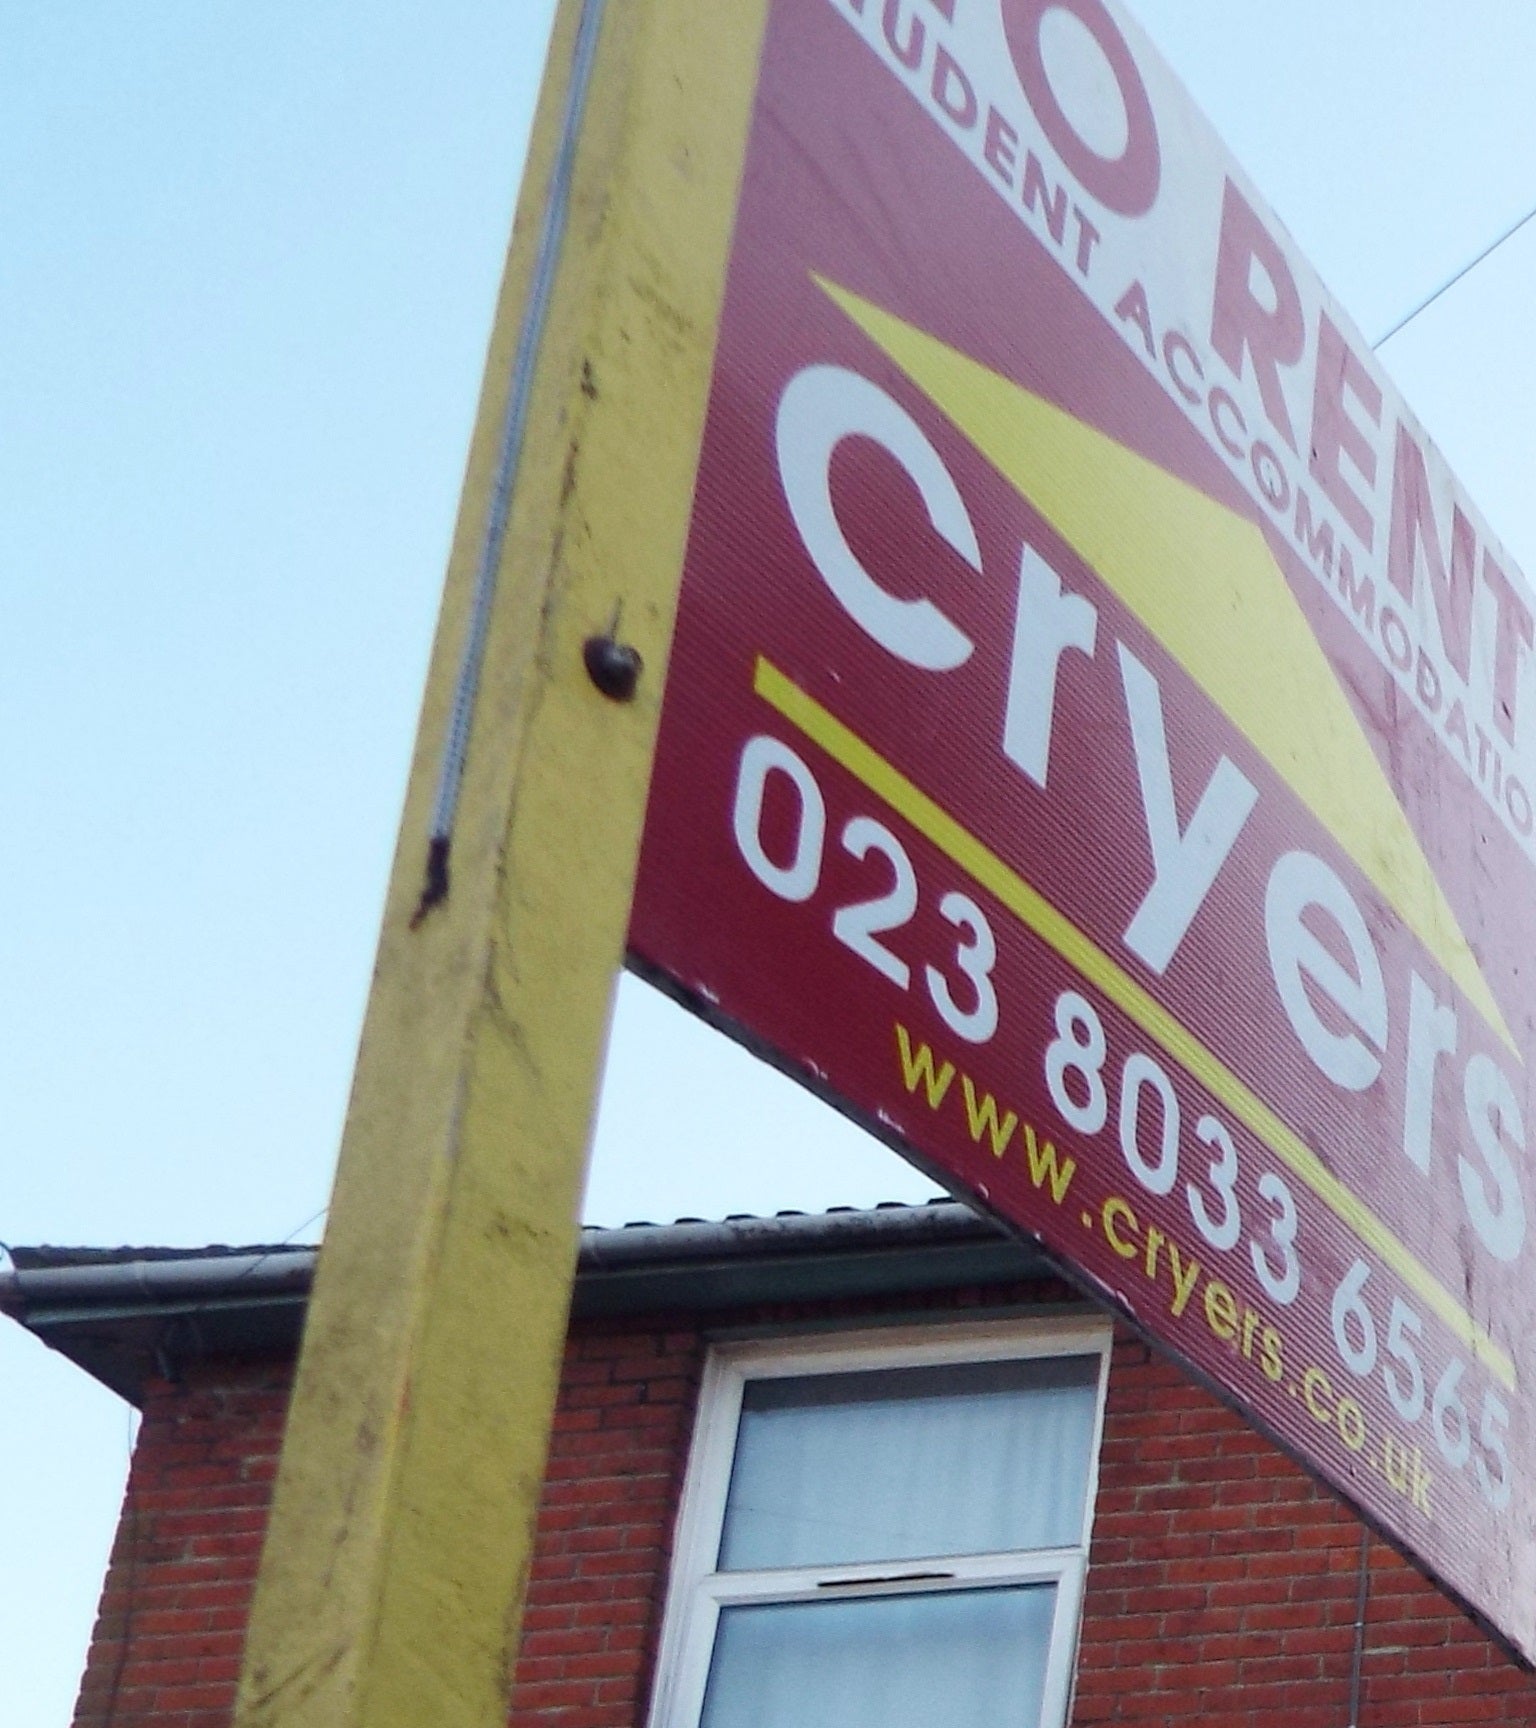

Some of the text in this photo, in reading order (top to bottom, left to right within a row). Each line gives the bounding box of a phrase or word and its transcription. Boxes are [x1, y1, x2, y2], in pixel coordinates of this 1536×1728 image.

[848, 0, 1100, 278] UDENT
[929, 0, 1535, 748] O RENT
[733, 735, 1511, 1512] 023 8033 6565
[894, 1022, 1434, 1519] www.cryers.co.uk
